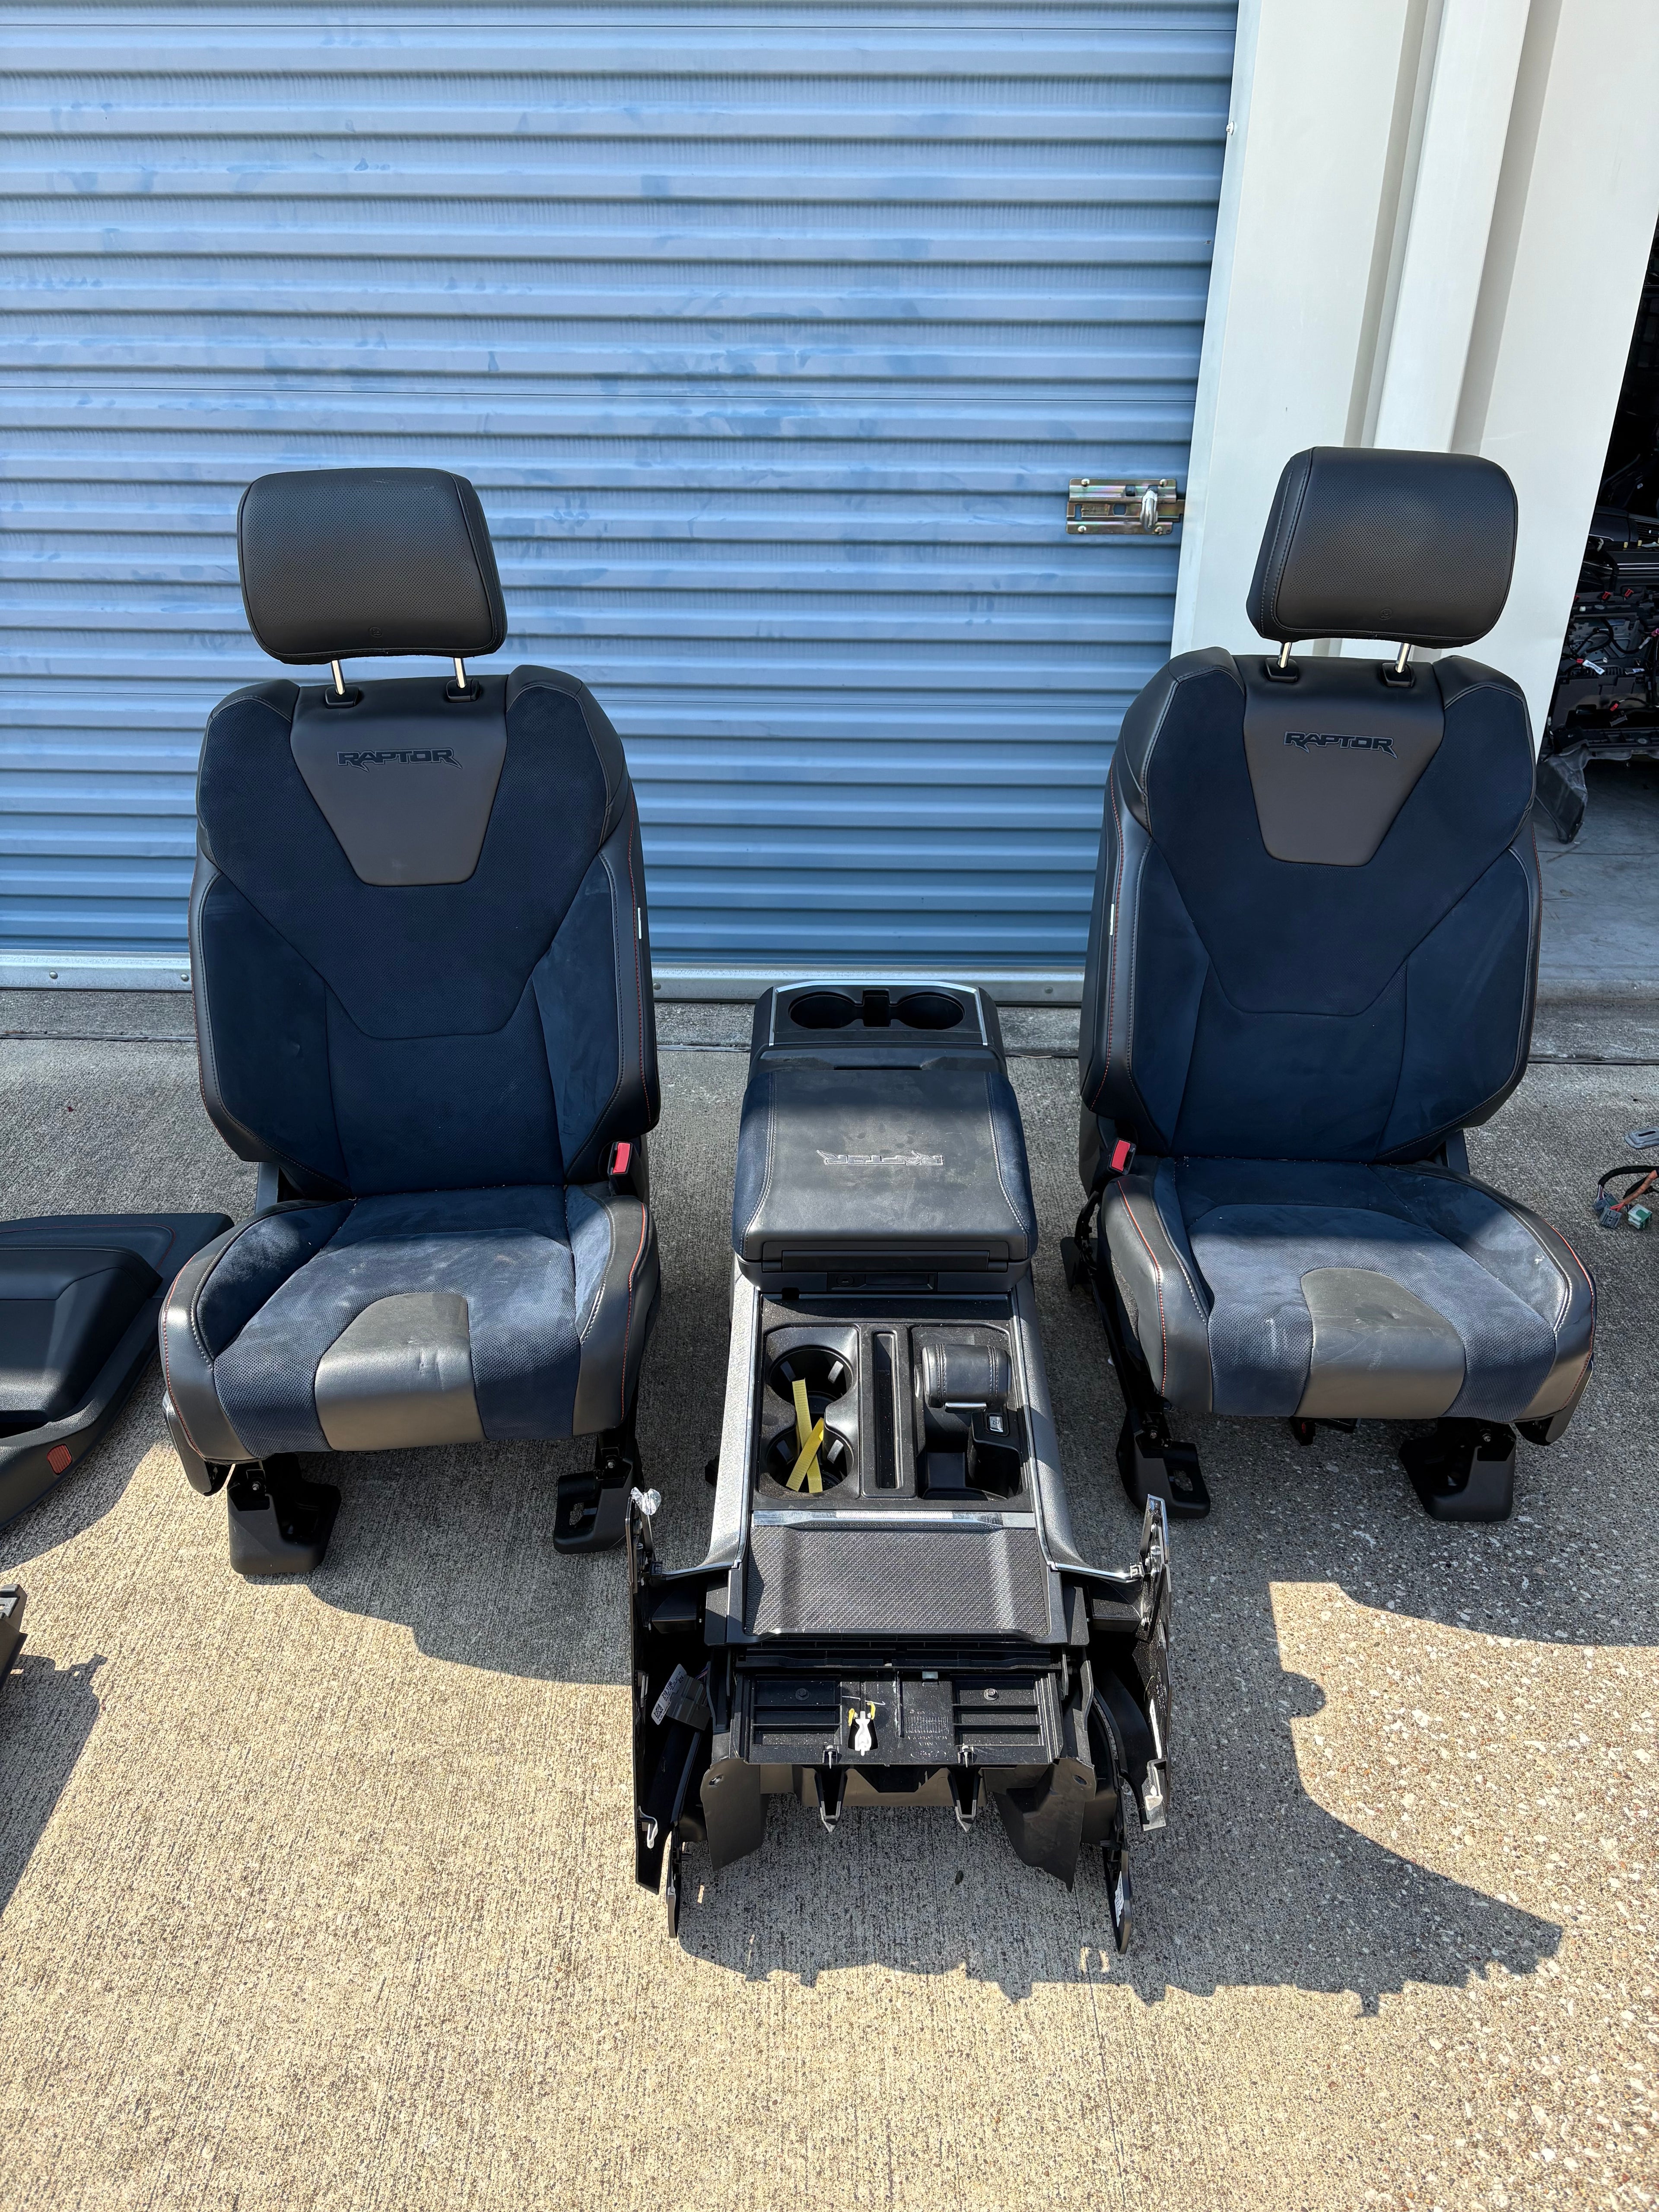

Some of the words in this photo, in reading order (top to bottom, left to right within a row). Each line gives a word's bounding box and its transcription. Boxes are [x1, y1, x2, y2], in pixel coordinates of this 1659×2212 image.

[1284, 731, 1398, 759] RAPTOR
[337, 747, 463, 772] RAPTOR
[817, 1150, 944, 1166] RAPTOR
